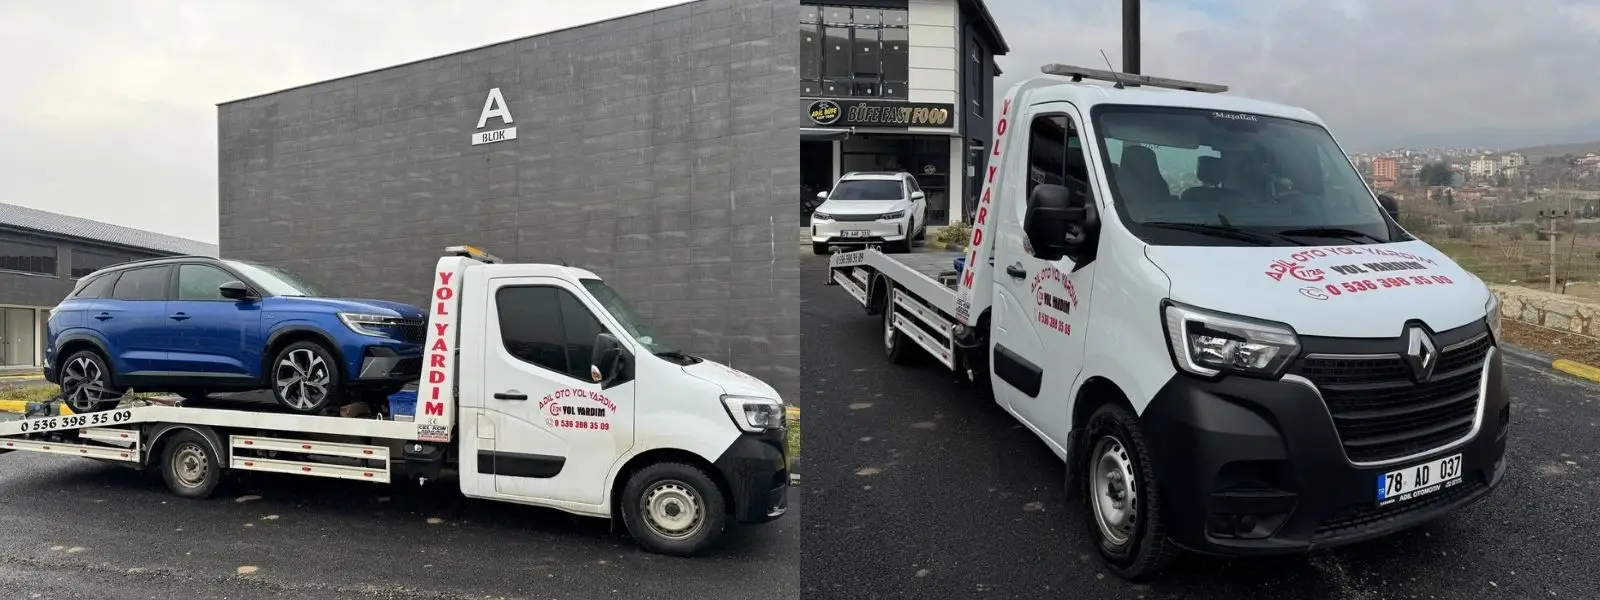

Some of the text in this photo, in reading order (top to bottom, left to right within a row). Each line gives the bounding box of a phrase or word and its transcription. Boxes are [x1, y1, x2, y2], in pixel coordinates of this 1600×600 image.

[476, 87, 514, 129] A
[848, 103, 948, 124] BÜFE FAST FOOD
[482, 130, 505, 143] BLOK
[993, 99, 1011, 156] YOL
[963, 166, 997, 290] YARDIM
[1291, 249, 1327, 262] OTO
[1324, 247, 1362, 255] YOL
[1361, 247, 1439, 266] YARDIM
[1298, 268, 1325, 277] 7/24
[1330, 261, 1427, 275] YOL YARDIM
[436, 272, 453, 315] YOL
[1325, 275, 1455, 296] 0 536 398 35 09
[425, 323, 449, 417] YARDIM
[555, 388, 570, 399] OTO
[572, 388, 587, 398] YOL
[589, 391, 617, 414] YARDIM
[562, 406, 606, 417] YOL YARDIM
[20, 410, 132, 432] 0 536 398 35 09
[561, 420, 574, 428] 536
[575, 420, 588, 429] 398
[590, 422, 598, 430] 35
[600, 422, 610, 431] 09
[1386, 472, 1403, 496] 78
[1415, 465, 1430, 488] AD
[1440, 456, 1460, 480] 037
